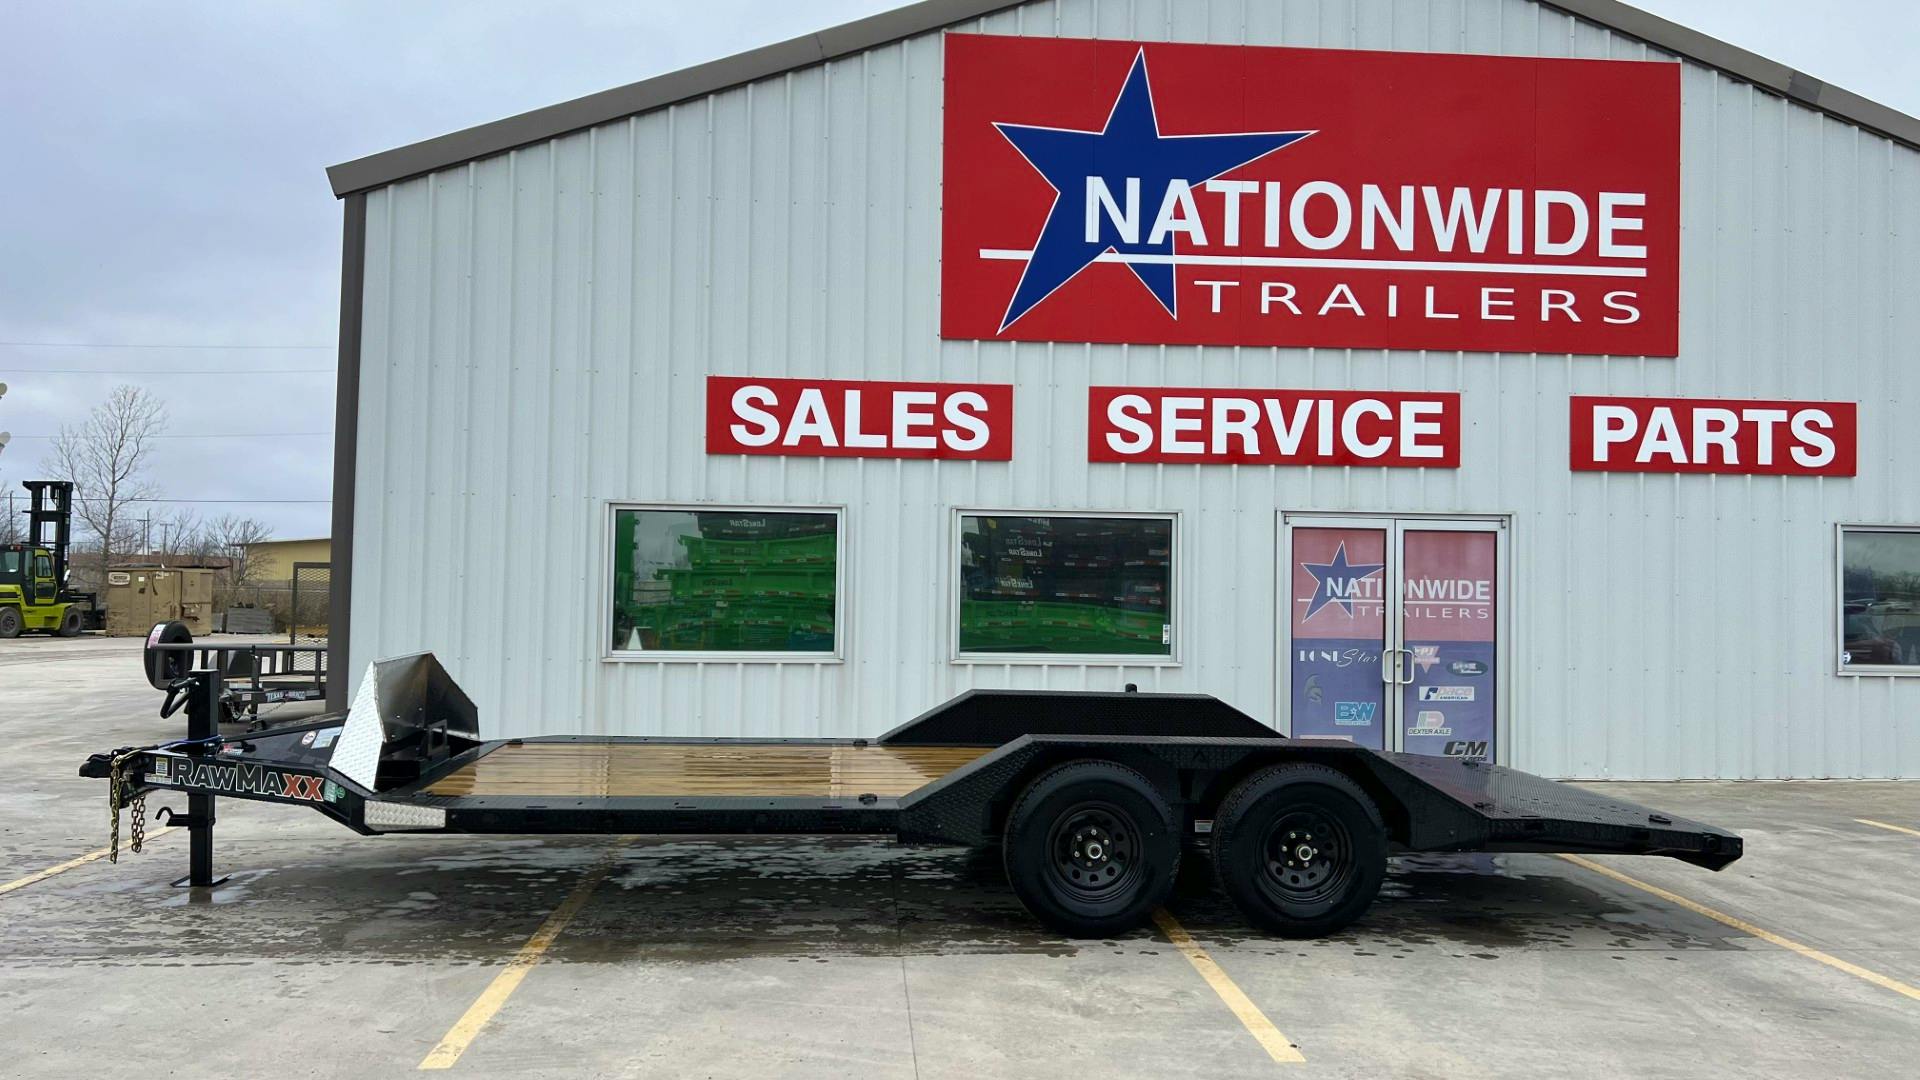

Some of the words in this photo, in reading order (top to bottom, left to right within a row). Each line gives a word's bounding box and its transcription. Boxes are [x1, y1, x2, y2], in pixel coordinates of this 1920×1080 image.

[1085, 176, 1647, 259] NATIONWIDE
[1193, 279, 1641, 325] TRAILERS
[730, 385, 990, 452] SALES
[1105, 394, 1444, 459] SERVICE
[1592, 405, 1836, 468] PARTS
[1326, 577, 1490, 600] NATINWIDE
[1443, 741, 1488, 756] CM
